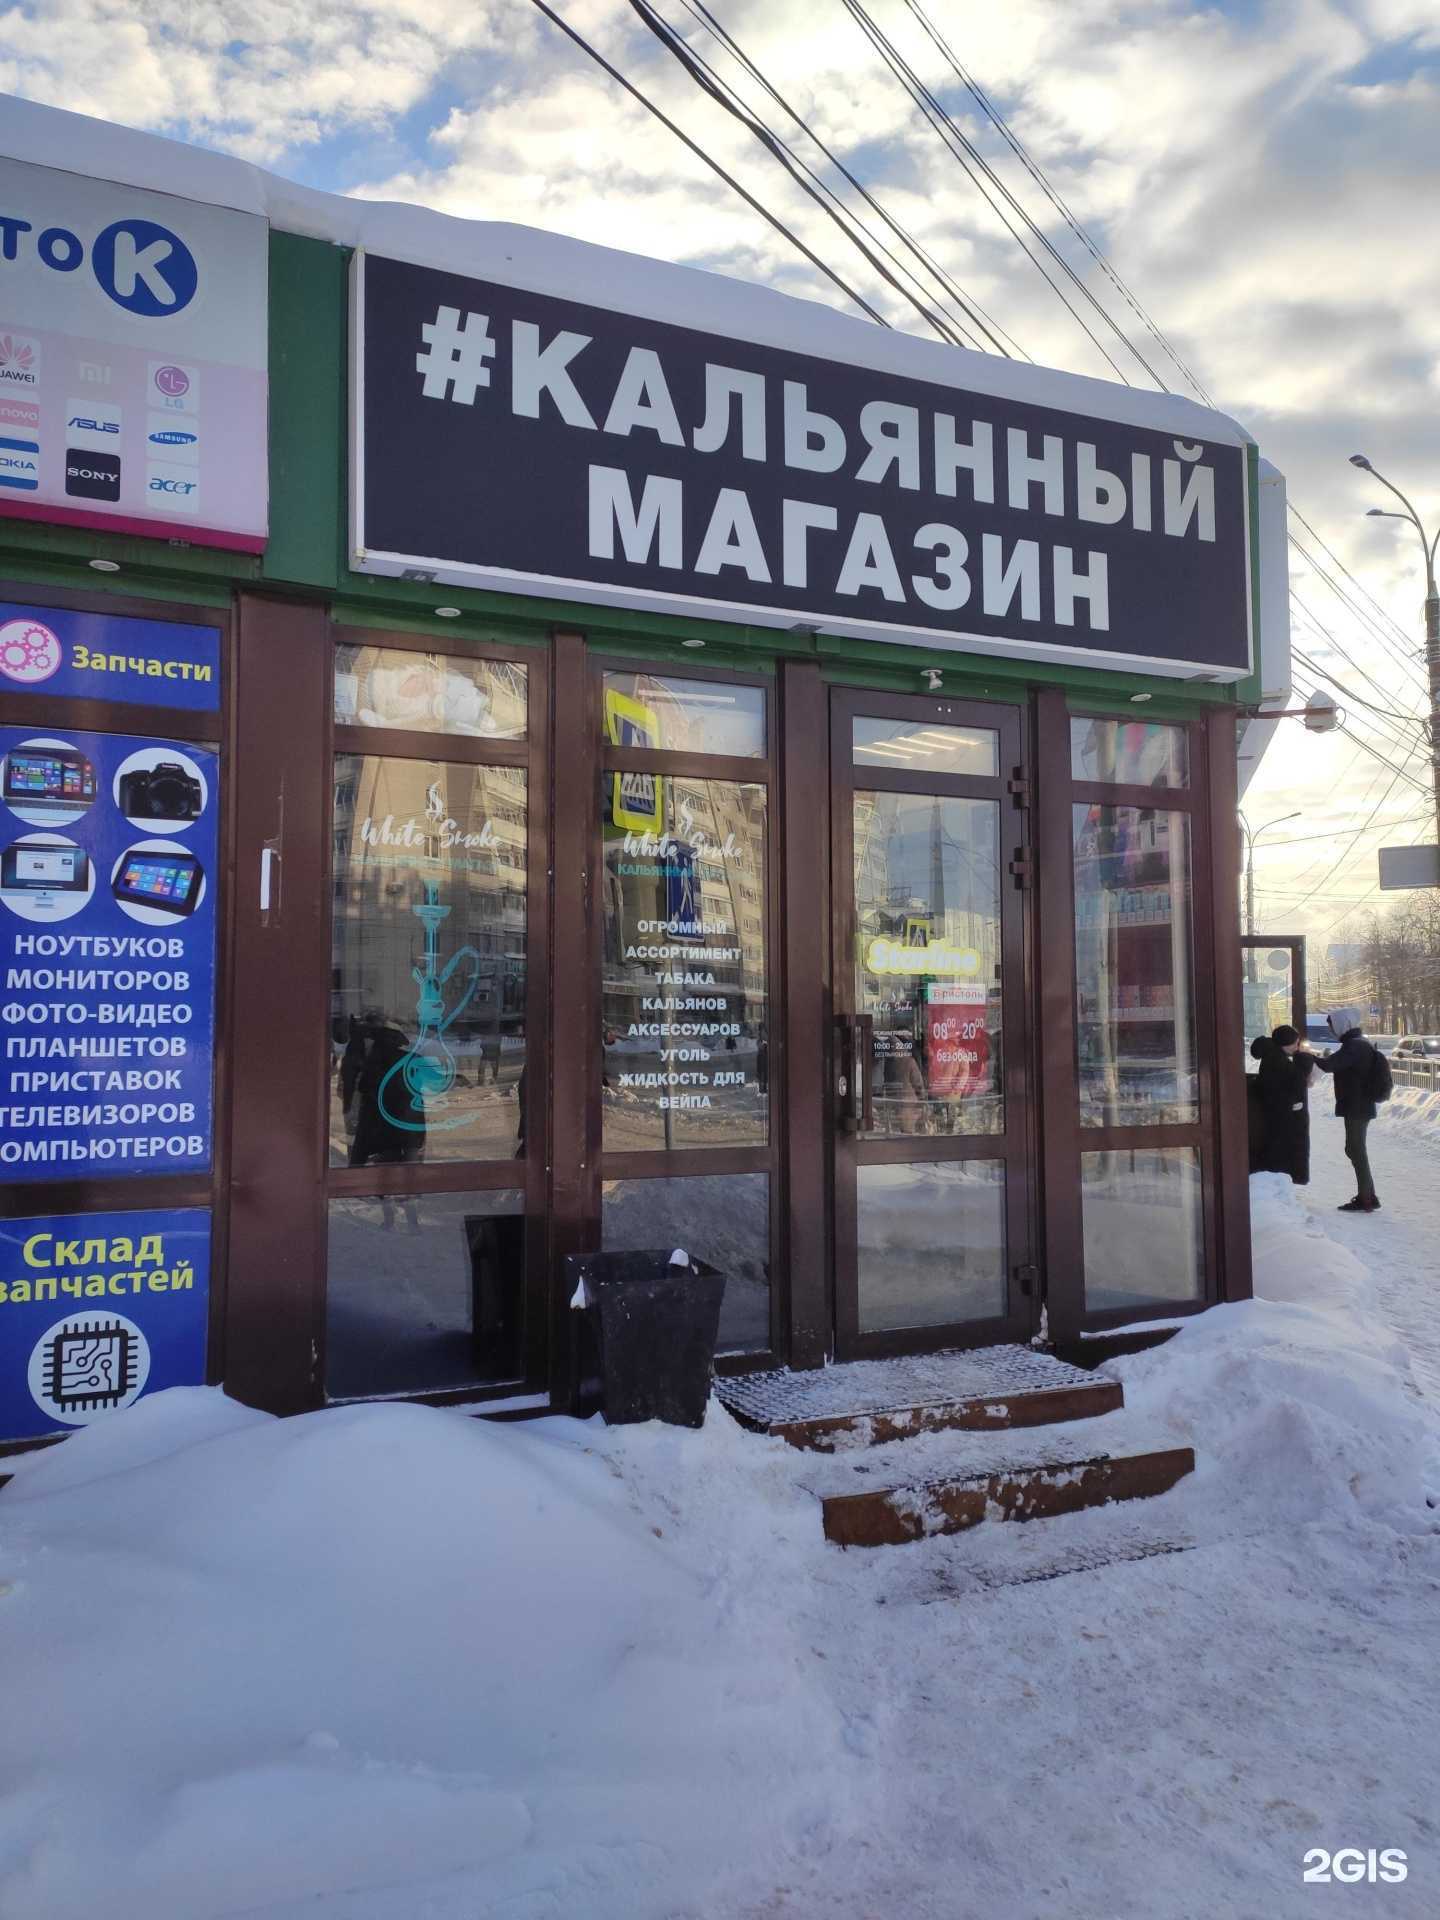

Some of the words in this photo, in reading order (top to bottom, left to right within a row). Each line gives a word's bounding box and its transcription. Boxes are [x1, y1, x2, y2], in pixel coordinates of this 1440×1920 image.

[68, 417, 120, 434] ASUS
[416, 305, 1217, 543] #КАЛЬЯННЫЙ
[67, 467, 119, 482] SONY
[149, 477, 197, 495] acer
[587, 464, 1110, 632] МАГАЗИН
[71, 645, 212, 682] Запчасти
[360, 815, 425, 849] White
[439, 817, 500, 850] Smoke
[623, 830, 679, 860] White
[689, 831, 743, 861] Smoke
[637, 919, 727, 935] ОГРОМНЫЙ
[15, 934, 184, 958] НОУТБУКОВ
[625, 945, 741, 960] АССОРТИМЕНТ
[6, 969, 190, 991] МОНИТОРОВ
[655, 972, 715, 985] ТАБАКА
[642, 998, 727, 1010] КАЛЬЯНОВ
[2, 1002, 193, 1028] ФОТО-ВИДЕО
[627, 1023, 741, 1036] АКСЕССУАРОВ
[6, 1037, 187, 1058] ПЛАНШЕТОВ
[660, 1049, 710, 1062] УГОЛЬ
[10, 1070, 183, 1093] ПРИСТАВОК
[618, 1073, 709, 1088] ЖИДКОСТЬ
[713, 1072, 745, 1087] ДЛЯ
[659, 1095, 712, 1109] ВЕЙПА
[23, 1233, 164, 1268] Склад
[0, 1260, 194, 1302] запчастей
